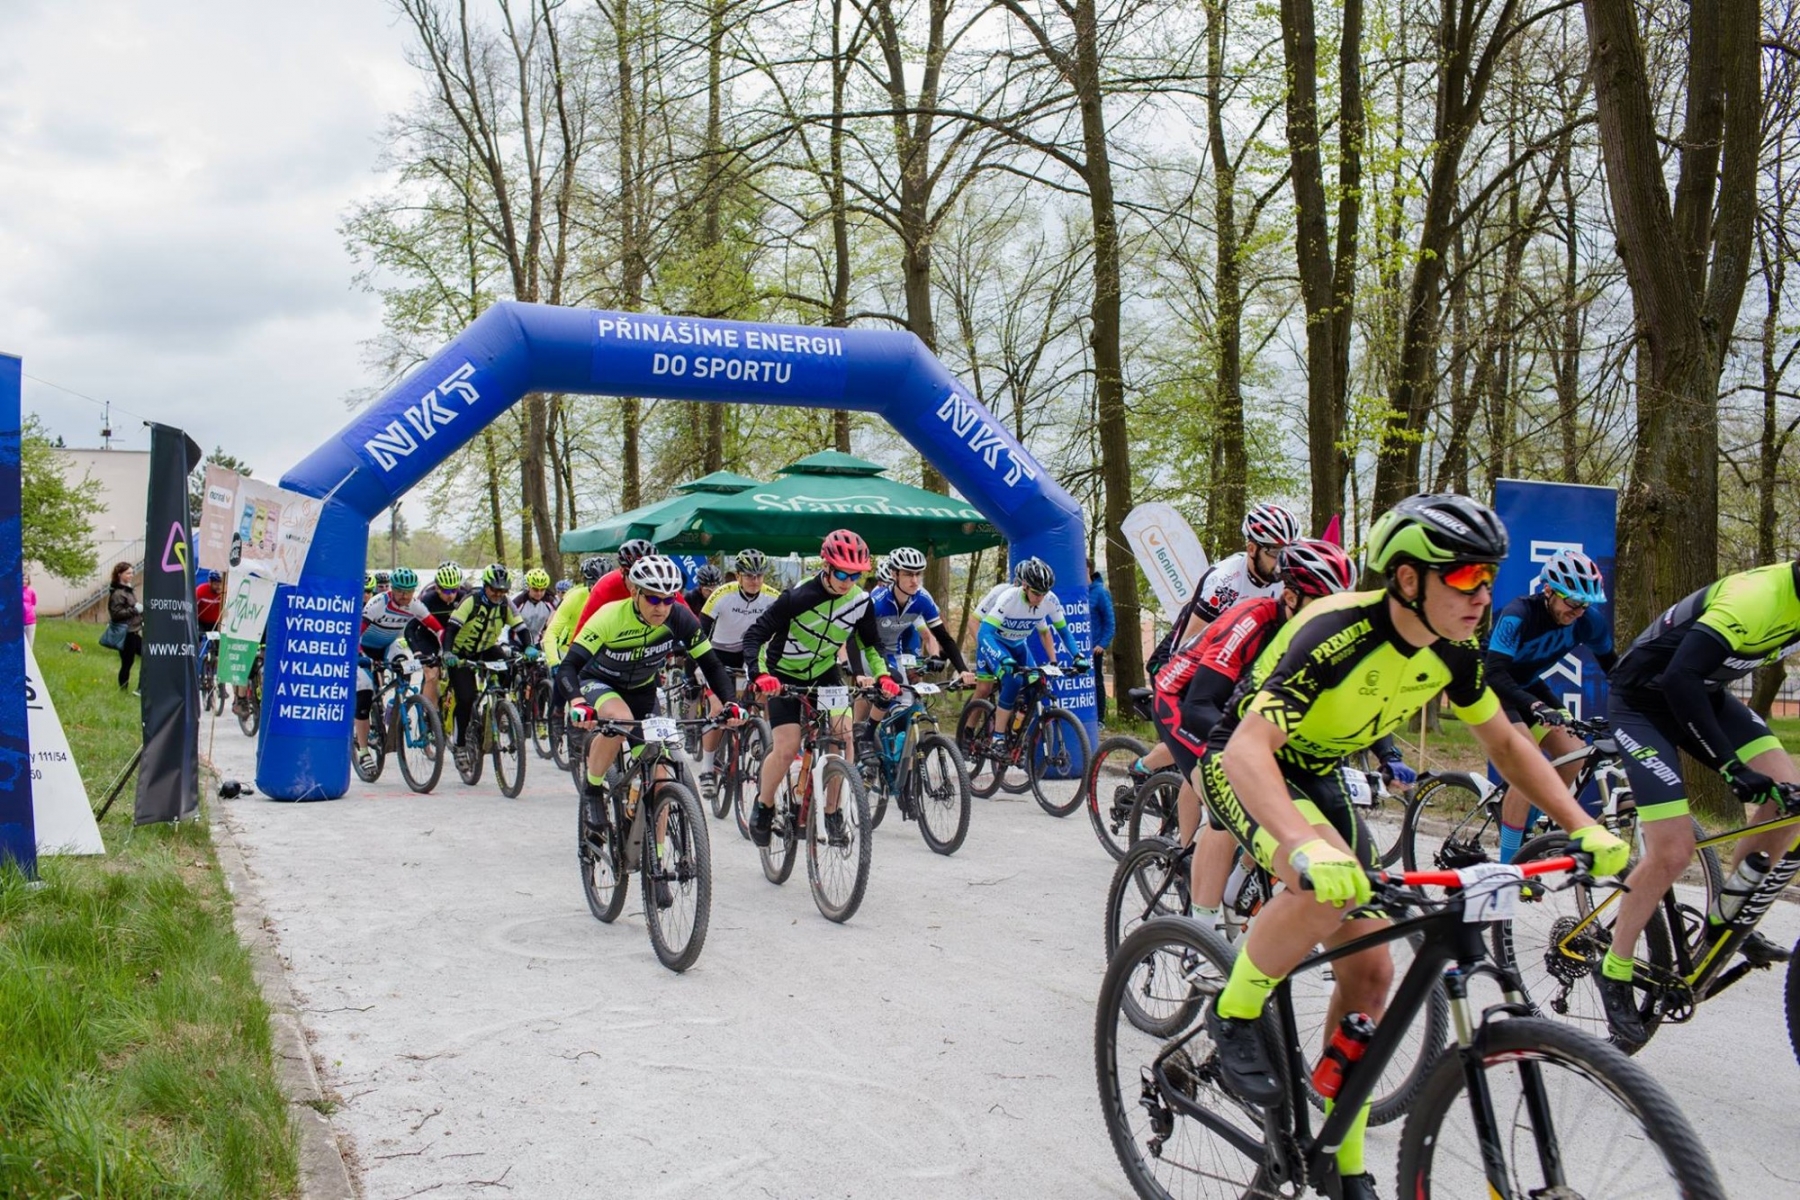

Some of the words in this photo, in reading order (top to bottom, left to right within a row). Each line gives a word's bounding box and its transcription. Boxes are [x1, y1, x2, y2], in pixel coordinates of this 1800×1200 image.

[598, 317, 739, 348] PŘINÁŠÍME
[746, 330, 842, 356] ENERGII
[652, 353, 687, 376] DO
[693, 357, 792, 384] SPORTU
[364, 362, 480, 472] NKT
[936, 392, 1036, 487] NKT
[287, 595, 355, 614] TRADIČNÍ
[286, 614, 352, 635] VÝROBCE
[288, 638, 347, 656] KABELŮ
[1310, 618, 1373, 664] PREMIUM
[280, 660, 288, 674] V
[292, 661, 350, 678] KLADNĚ
[277, 682, 286, 696] A
[290, 683, 348, 700] VELKÉM
[280, 703, 345, 722] MEZIŘÍČÍ
[38, 752, 67, 761] 111/54
